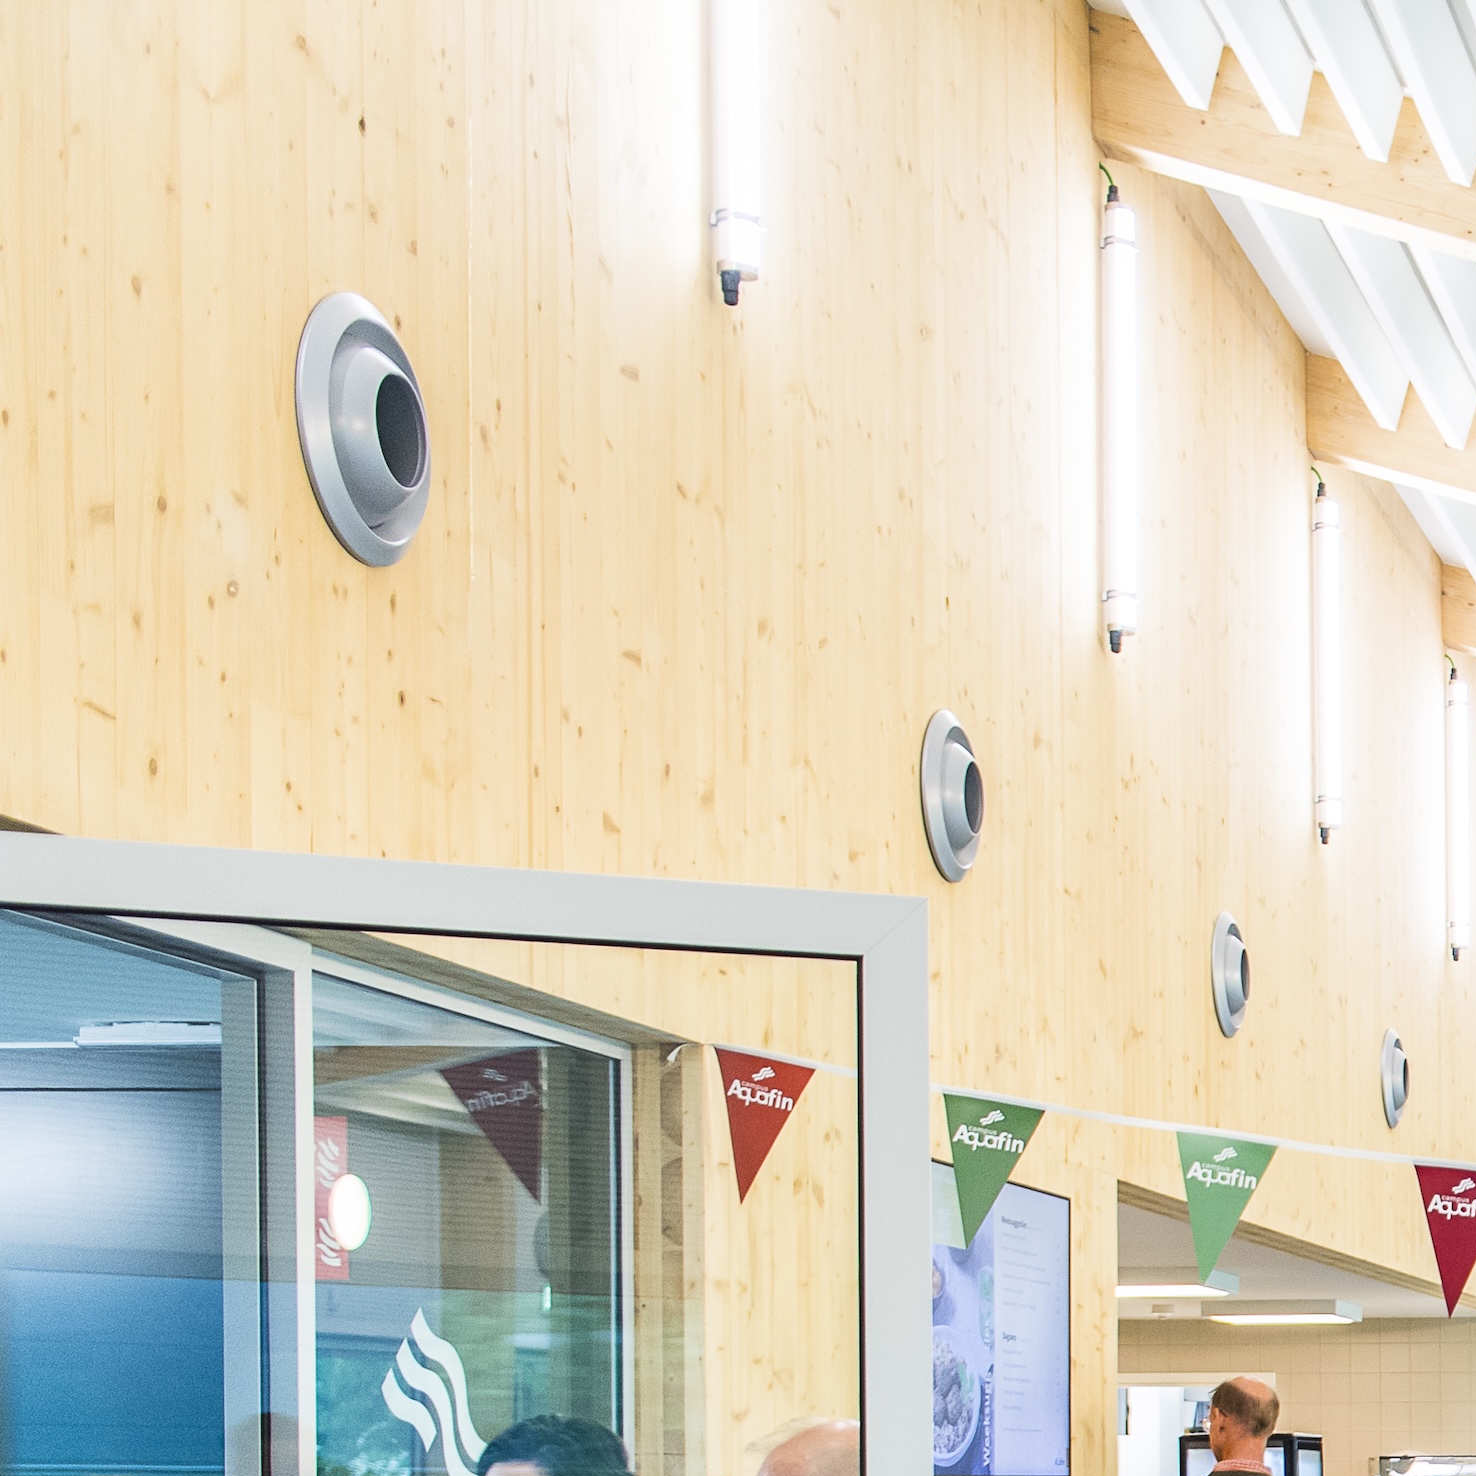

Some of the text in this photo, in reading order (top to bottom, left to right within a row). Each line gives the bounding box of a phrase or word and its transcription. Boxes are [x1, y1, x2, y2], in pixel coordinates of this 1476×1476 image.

[741, 1080, 769, 1091] campus
[727, 1079, 794, 1111] Aquafin
[968, 1124, 998, 1136] campus
[952, 1124, 1025, 1153] Aquafin
[1201, 1162, 1231, 1172] campus
[1186, 1161, 1258, 1190] Aquafin
[1441, 1195, 1470, 1204] campus
